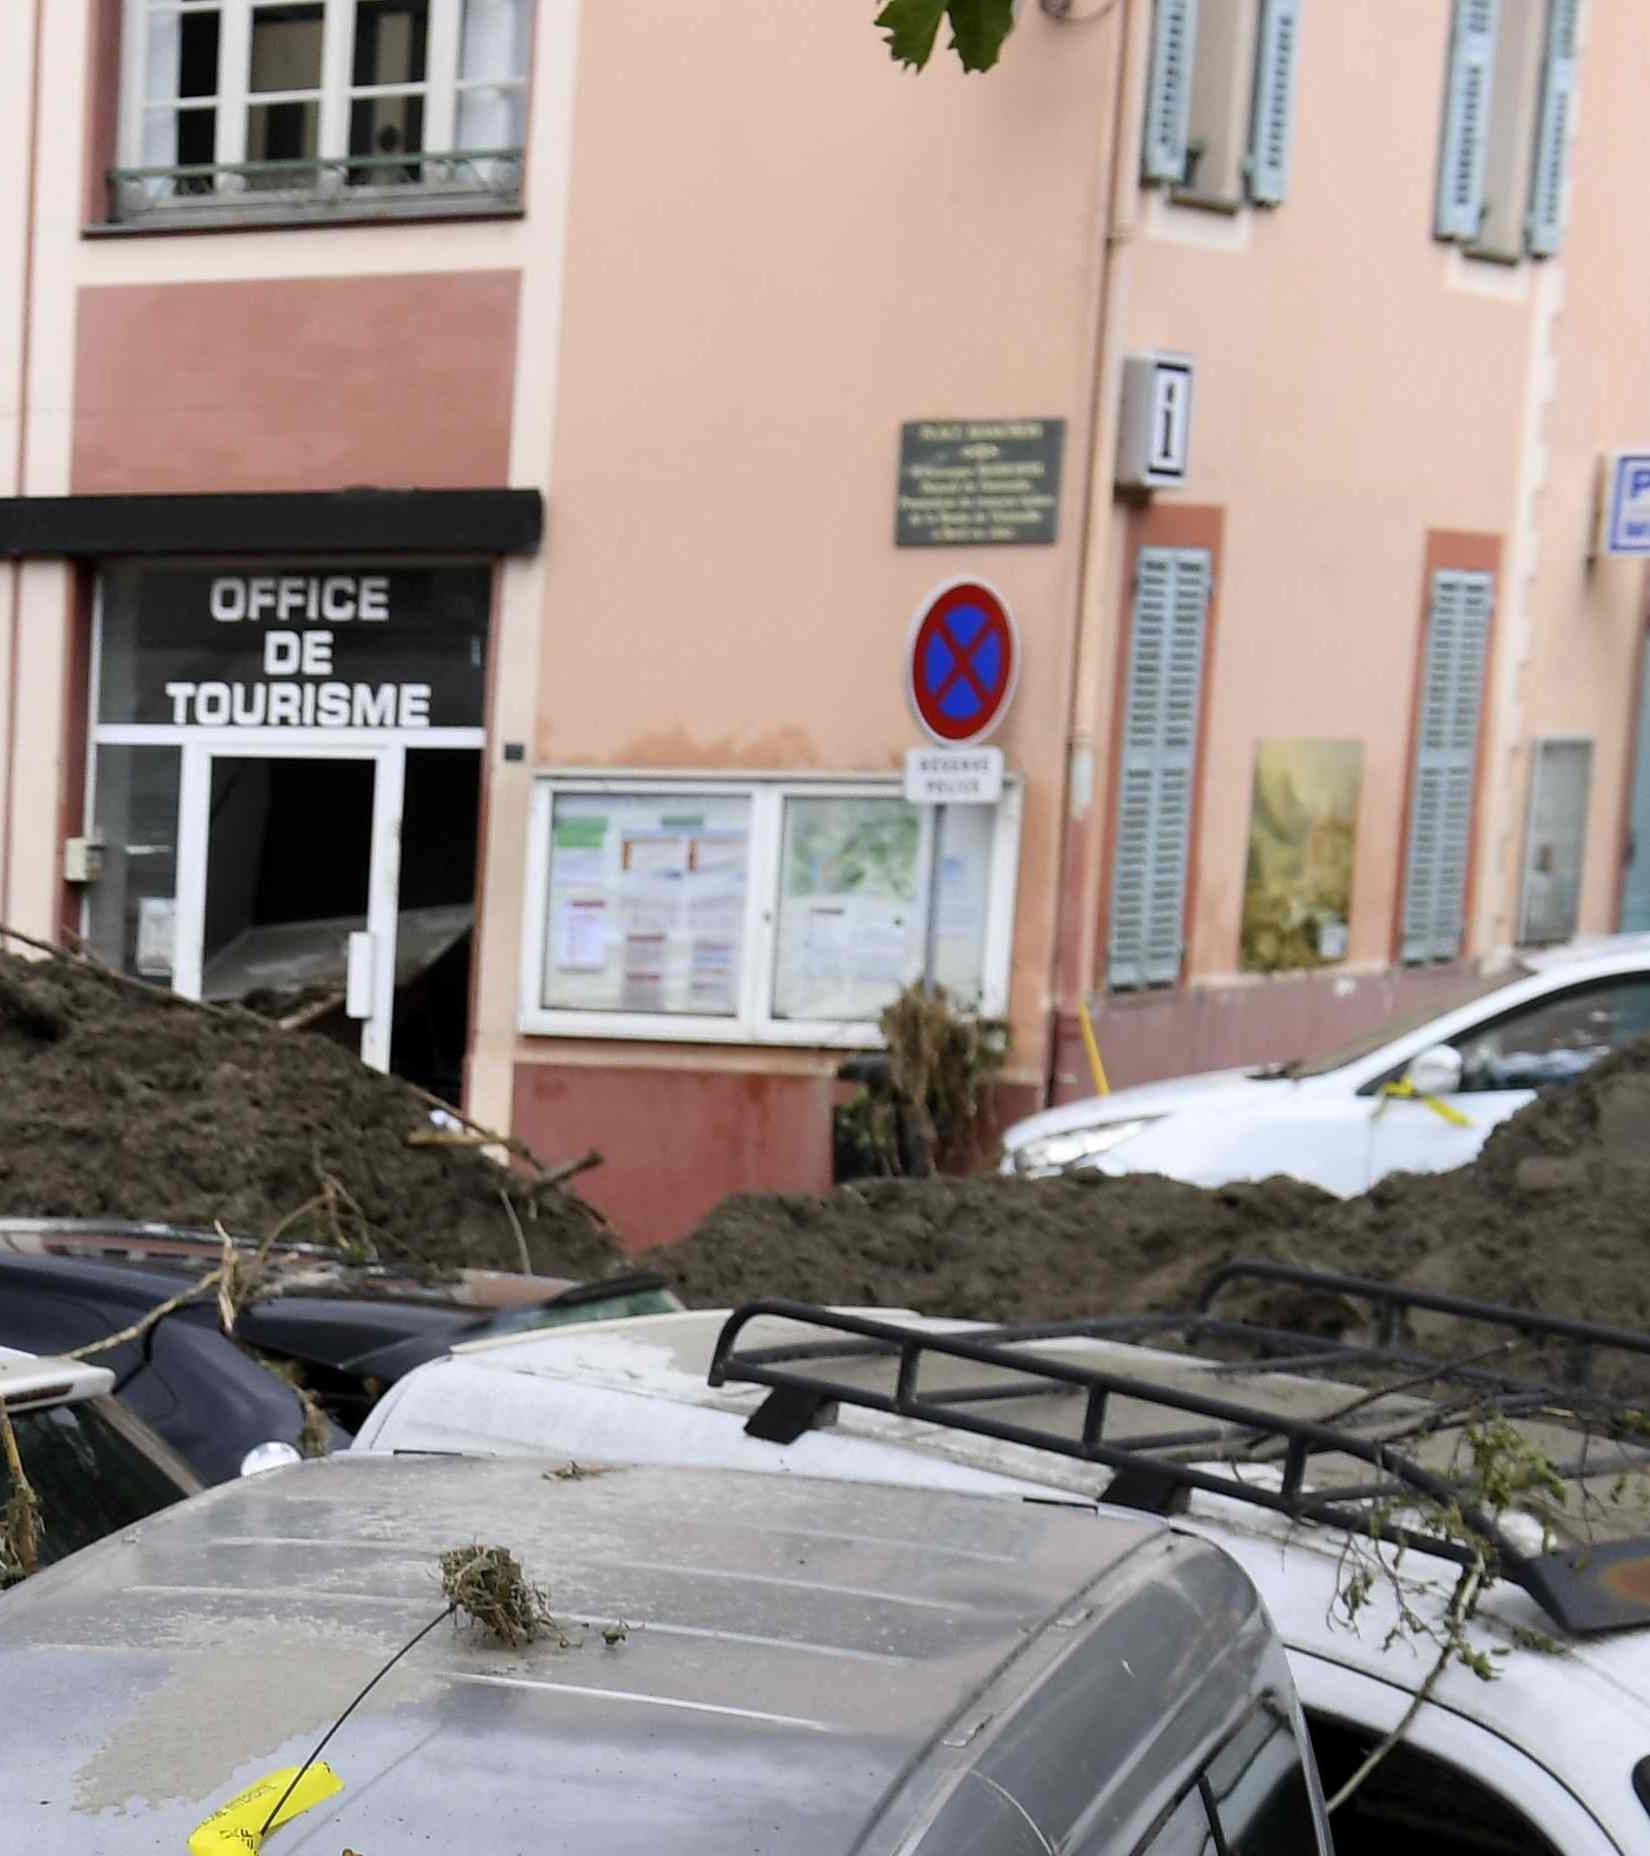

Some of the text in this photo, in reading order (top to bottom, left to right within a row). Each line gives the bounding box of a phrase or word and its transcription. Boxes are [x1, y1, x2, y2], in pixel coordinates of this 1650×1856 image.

[210, 577, 390, 621] OFFICE
[263, 630, 334, 675] DE
[165, 682, 432, 726] TOURISME
